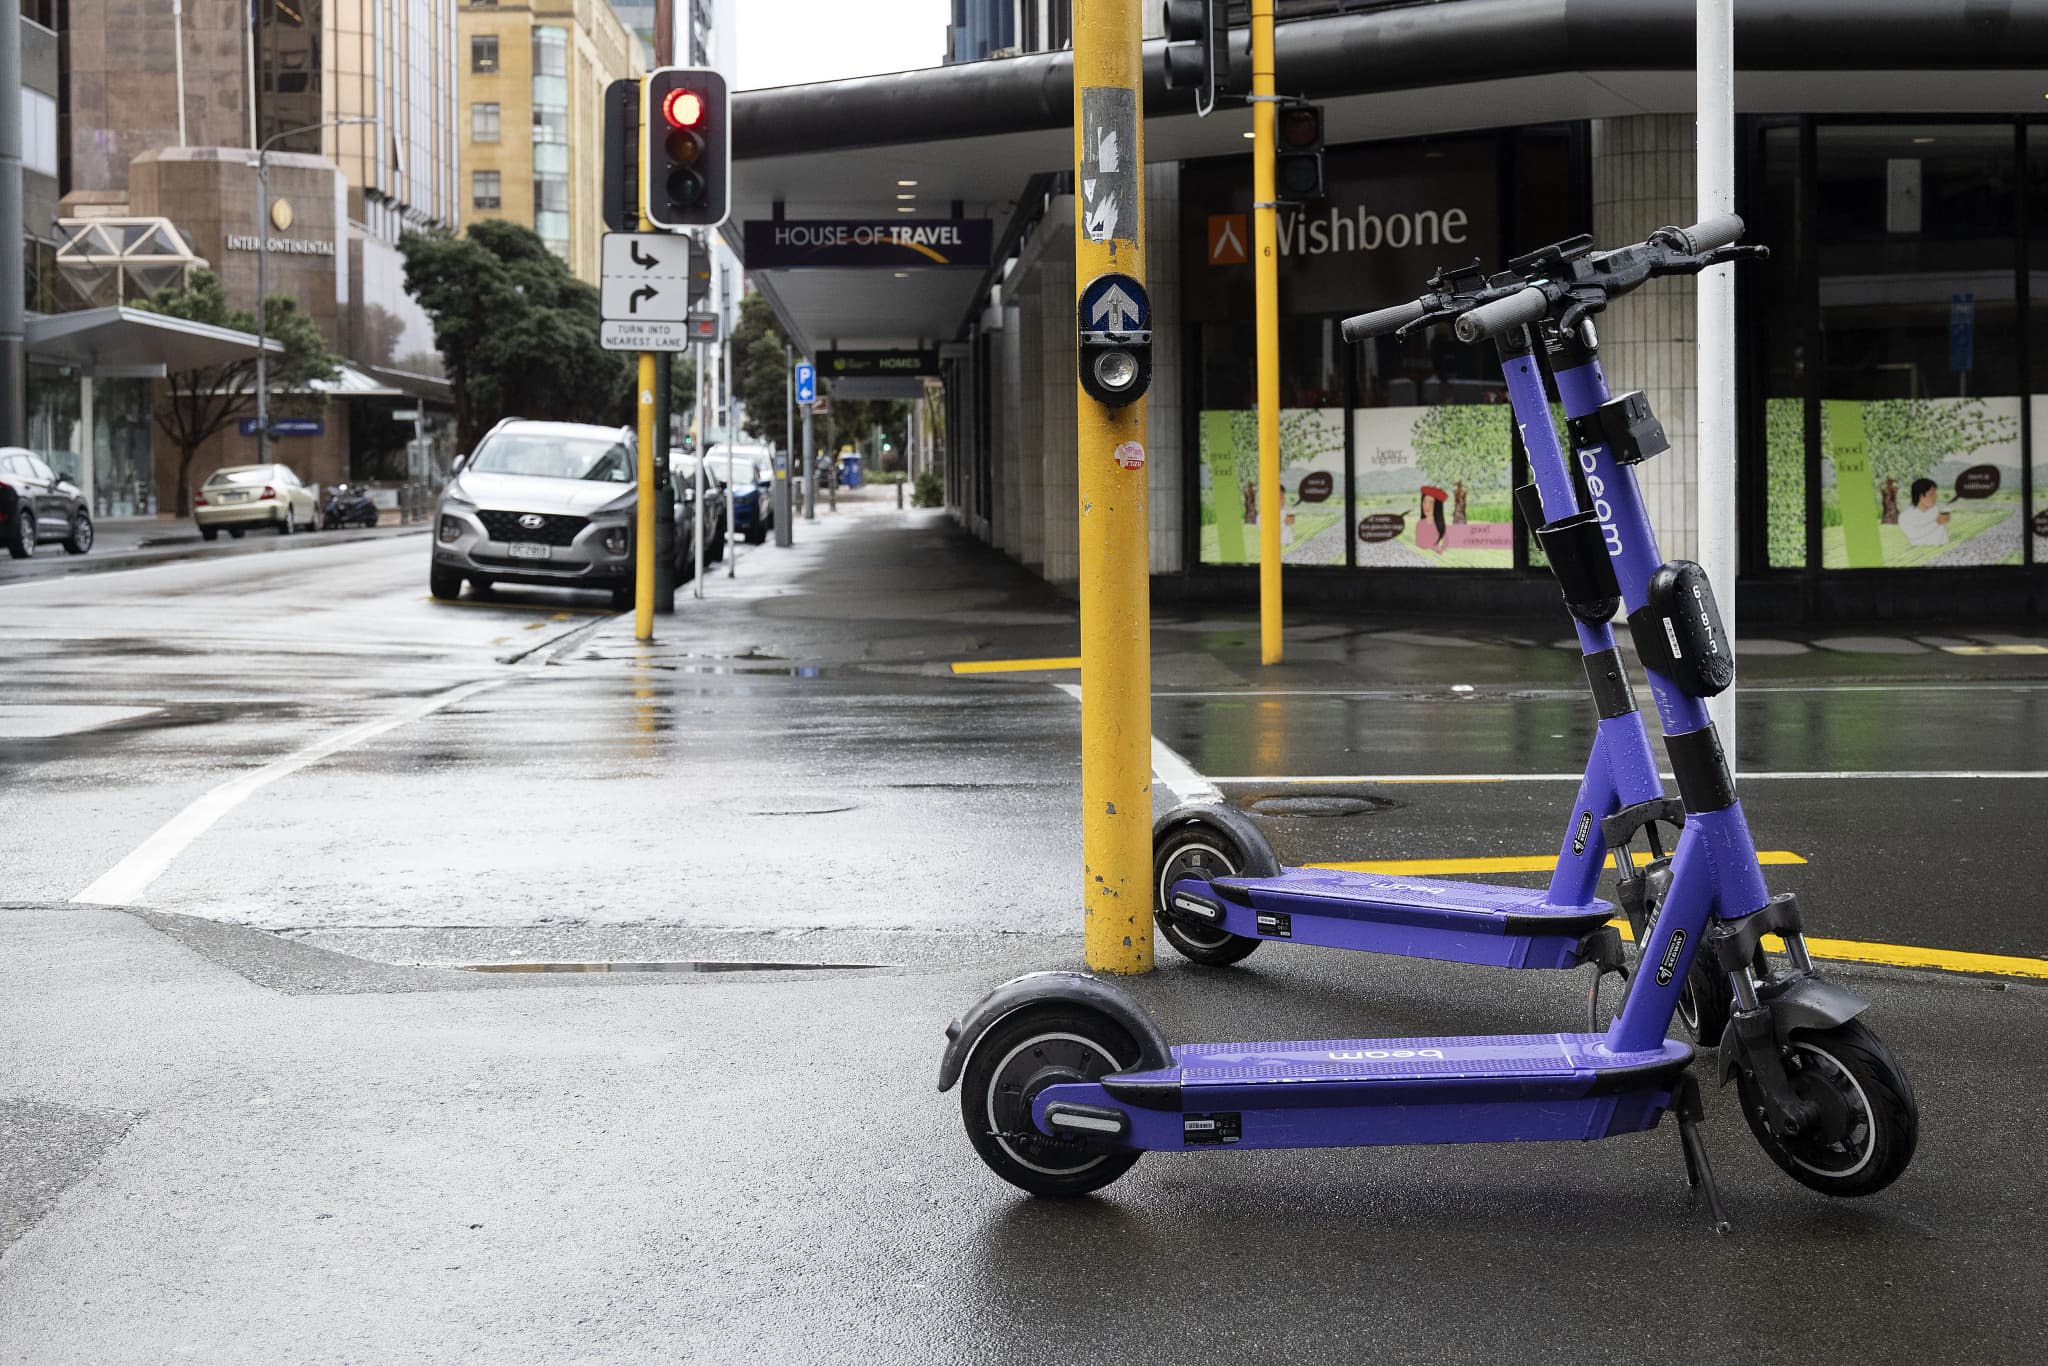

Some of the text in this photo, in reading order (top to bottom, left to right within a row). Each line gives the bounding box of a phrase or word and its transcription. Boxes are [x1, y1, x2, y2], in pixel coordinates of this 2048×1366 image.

[775, 226, 962, 246] HOUSE OF TRAVEL
[227, 234, 335, 255] INTERONTINENTAL
[1264, 246, 1271, 257] 6
[618, 324, 671, 335] TURN INTO
[606, 336, 682, 347] NEAREST LANE
[879, 358, 921, 369] HOMES
[800, 367, 811, 384] P
[1833, 443, 1863, 456] good
[1838, 460, 1864, 473] food
[1580, 447, 1623, 556] beam
[1692, 584, 1718, 654] 61873
[1369, 881, 1446, 895] beam
[1668, 935, 1683, 968] SEGWAY
[1328, 1049, 1445, 1060] beam
